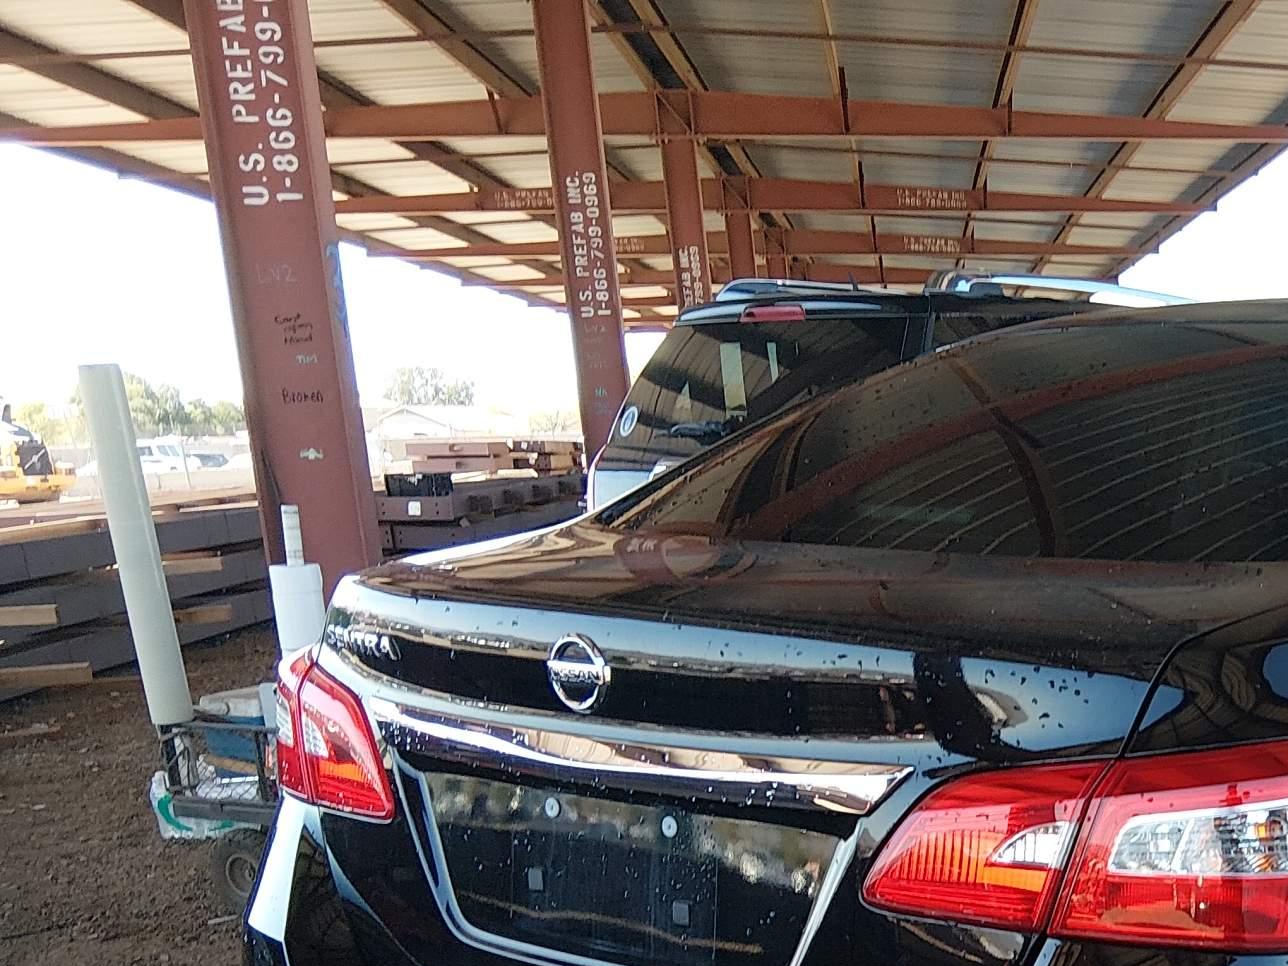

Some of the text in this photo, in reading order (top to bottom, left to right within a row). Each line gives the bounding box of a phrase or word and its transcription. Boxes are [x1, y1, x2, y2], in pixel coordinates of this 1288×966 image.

[253, 0, 304, 202] 1-866-799-
[239, 143, 270, 206] U.S.
[566, 170, 581, 204] INC.
[570, 211, 590, 278] PREFAB
[582, 171, 612, 316] 1-866-799-0969
[579, 285, 595, 318] U.S.
[281, 387, 324, 404] Broken
[327, 624, 398, 660] SENTRA
[548, 667, 602, 683] NISSAN
